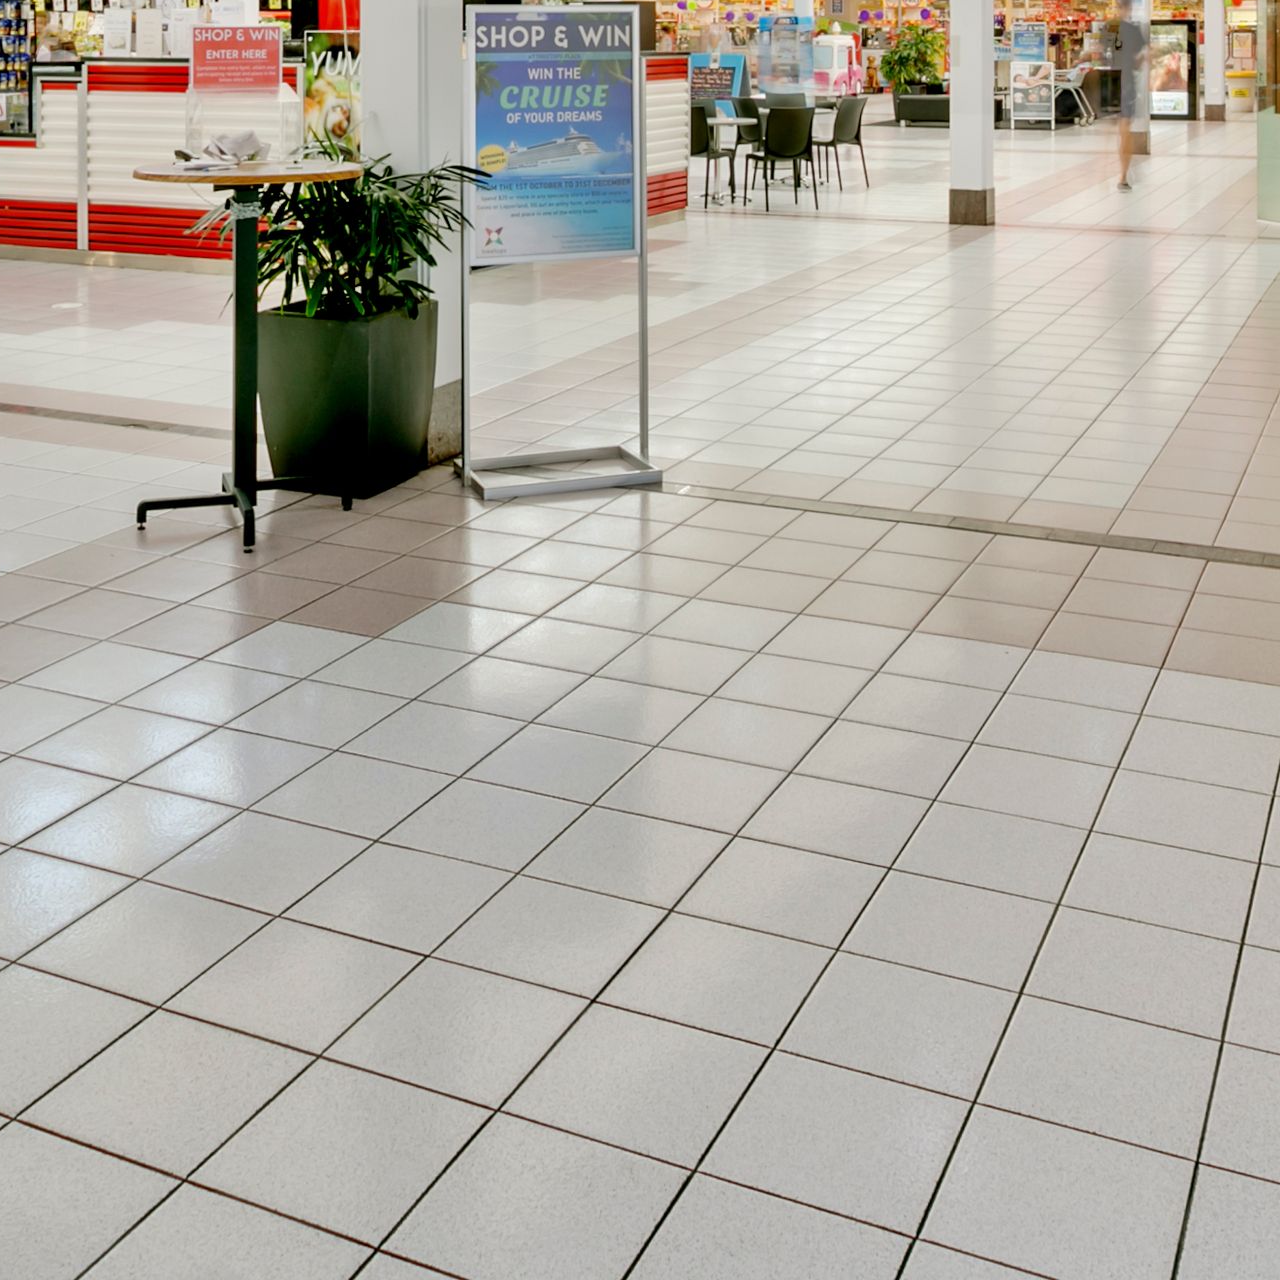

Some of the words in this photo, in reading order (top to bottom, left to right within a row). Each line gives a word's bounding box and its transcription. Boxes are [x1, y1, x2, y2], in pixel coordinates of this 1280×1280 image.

[194, 28, 233, 42] SHOP
[236, 29, 245, 42] &
[249, 29, 279, 41] WIN
[476, 25, 545, 49] SHOP
[554, 26, 568, 49] &
[578, 24, 631, 48] WIN
[205, 49, 238, 60] ENTER
[241, 48, 268, 60] HERE
[527, 67, 553, 81] WIN
[556, 67, 582, 80] THE
[499, 84, 610, 110] CRUISE
[506, 112, 522, 125] OF
[524, 111, 555, 124] YOUR
[556, 110, 603, 123] DREAMS
